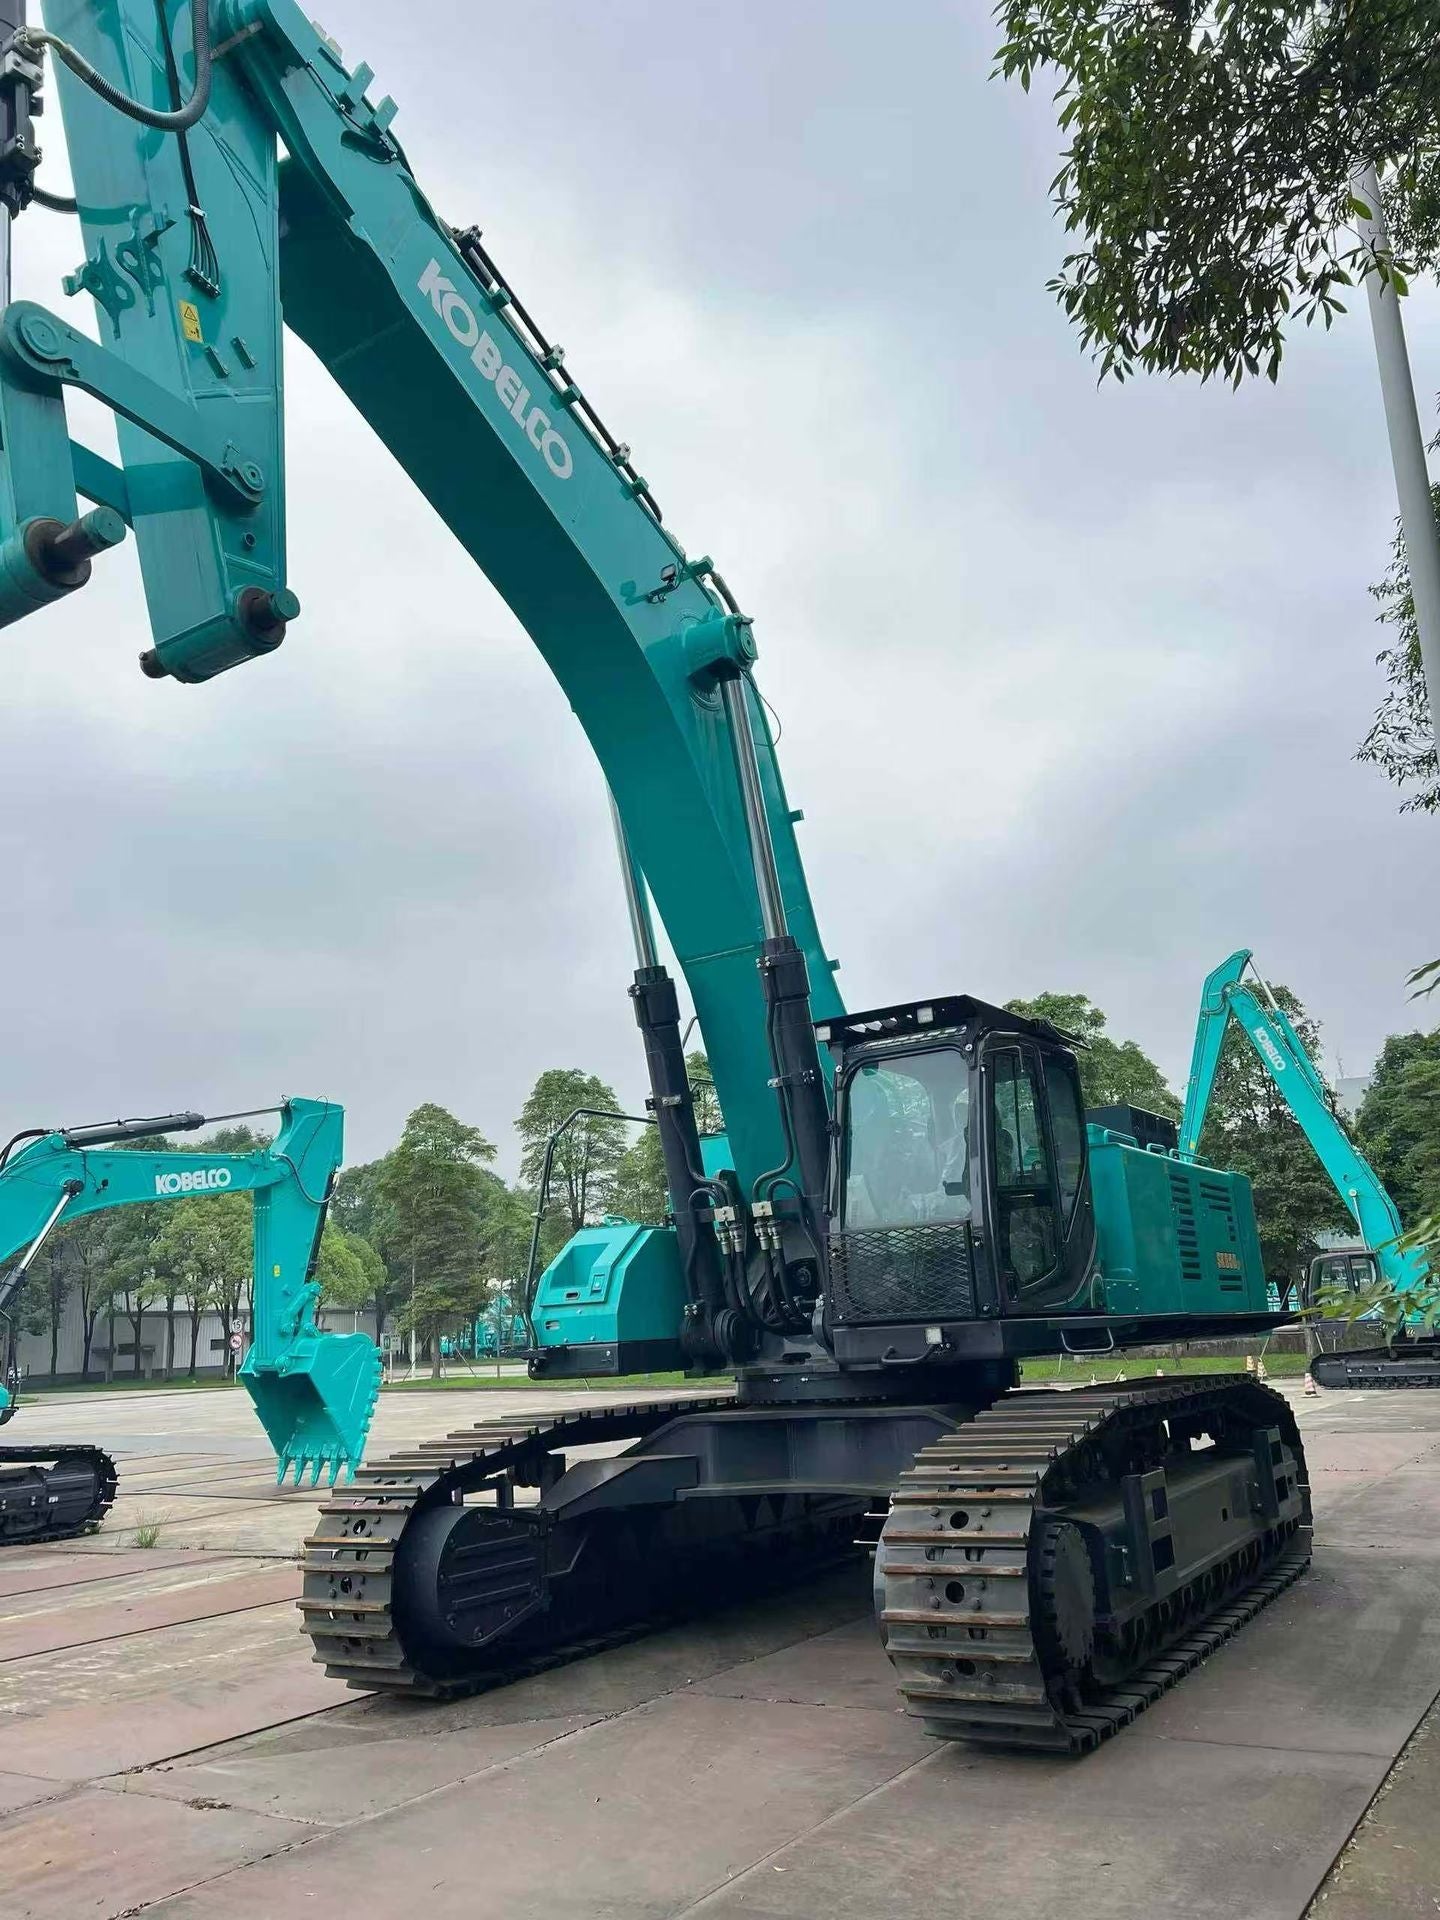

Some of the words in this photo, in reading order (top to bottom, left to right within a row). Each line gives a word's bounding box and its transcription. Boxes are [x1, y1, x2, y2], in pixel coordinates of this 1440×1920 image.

[417, 257, 573, 480] KOBELCO
[1253, 1027, 1286, 1071] KOBELCO
[155, 1168, 231, 1195] KOBELCO
[233, 1320, 241, 1330] 15
